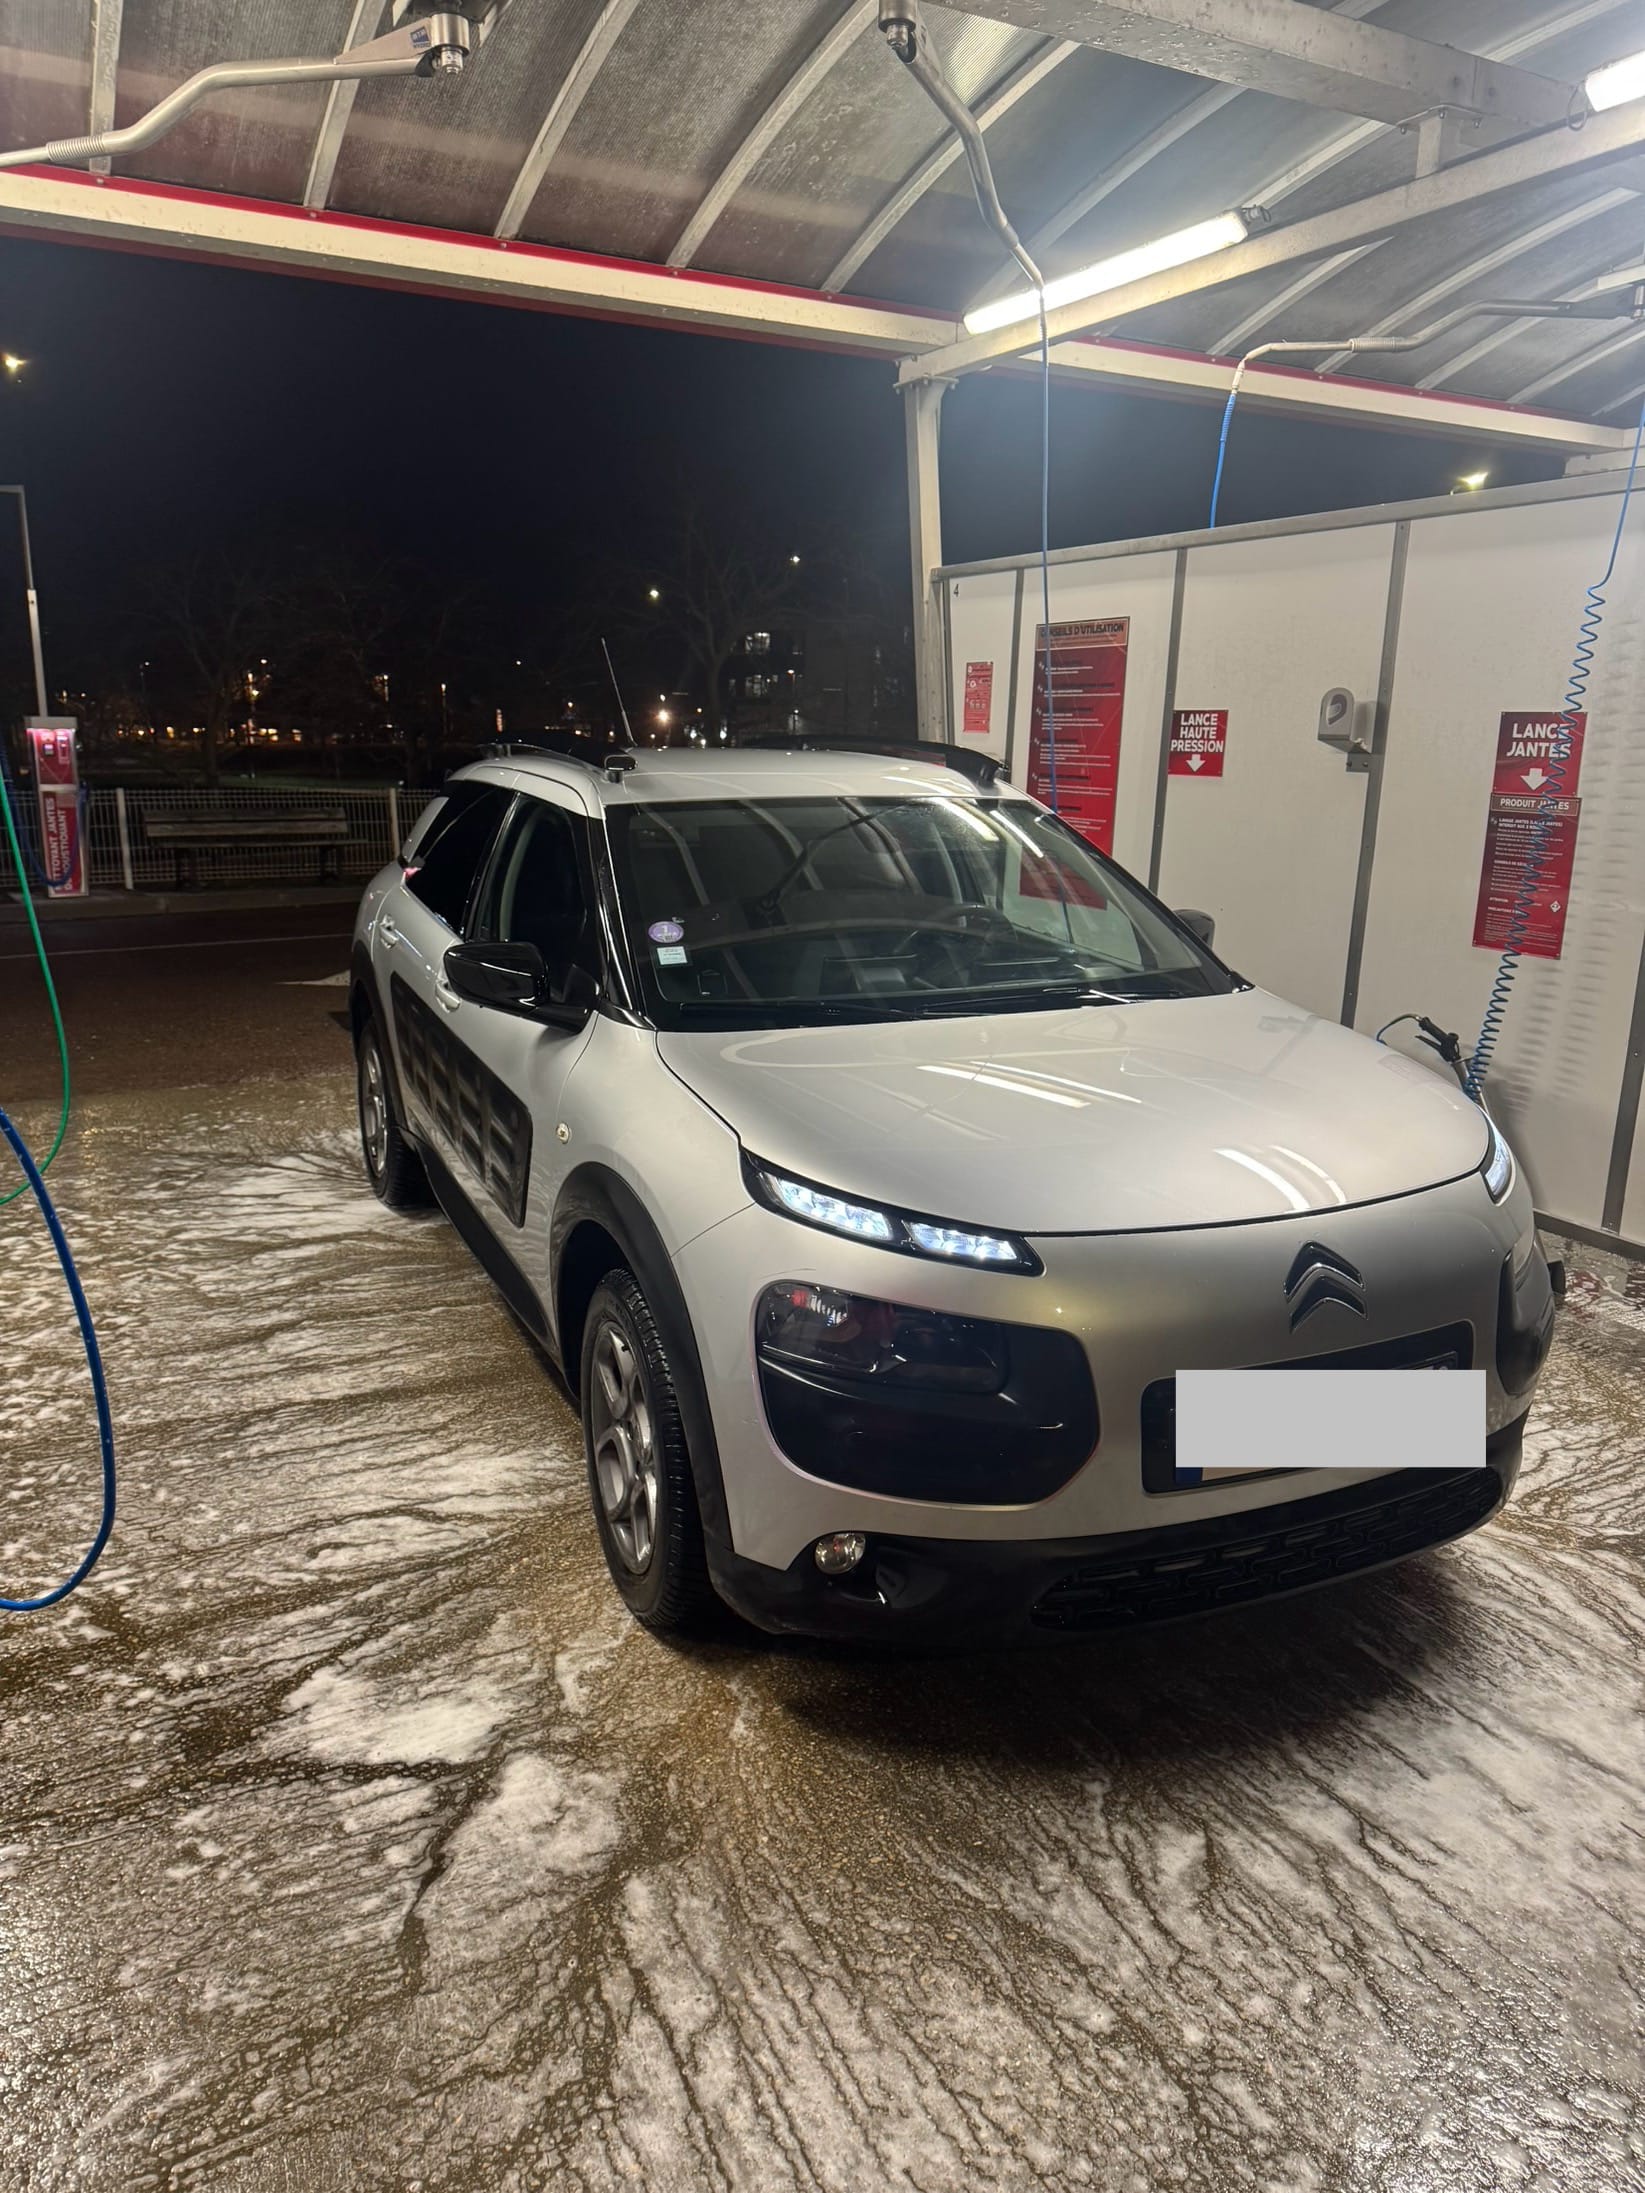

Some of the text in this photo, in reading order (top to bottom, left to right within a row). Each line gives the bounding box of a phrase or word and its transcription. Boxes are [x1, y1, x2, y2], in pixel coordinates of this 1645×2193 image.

[1181, 713, 1218, 726] LANCE
[1180, 726, 1217, 739] HAUTE
[1512, 723, 1571, 740] LANCE
[1170, 739, 1224, 753] PRESSION
[1506, 741, 1571, 759] JANTES
[1500, 798, 1536, 808] PRODUIT
